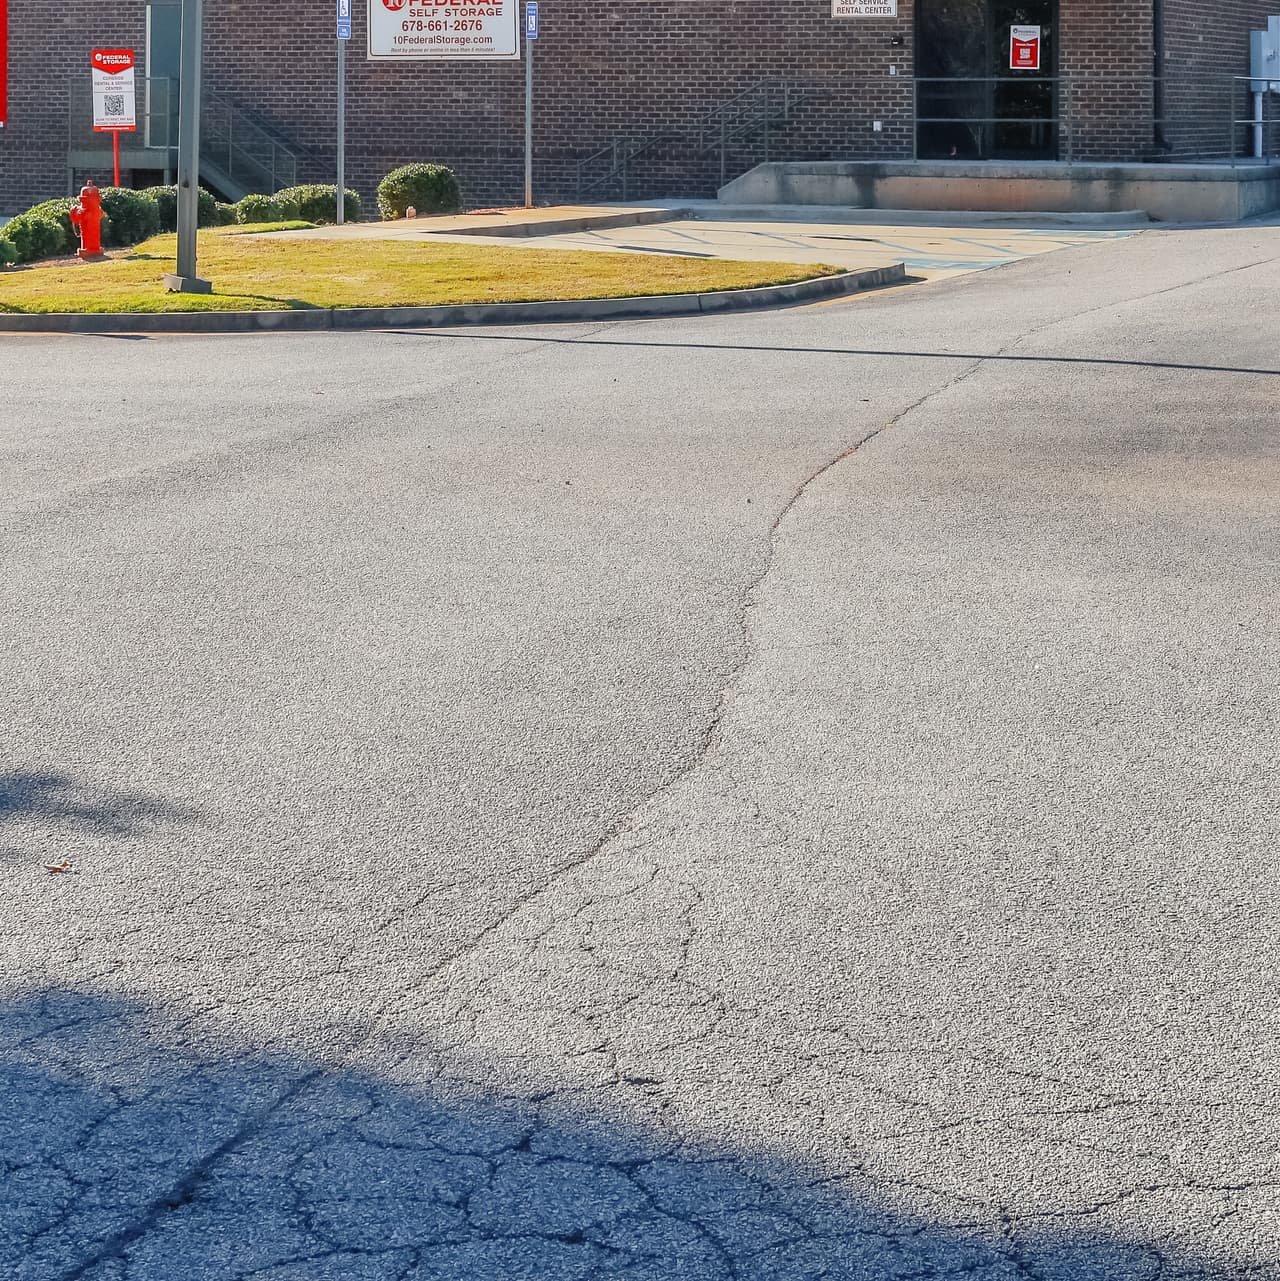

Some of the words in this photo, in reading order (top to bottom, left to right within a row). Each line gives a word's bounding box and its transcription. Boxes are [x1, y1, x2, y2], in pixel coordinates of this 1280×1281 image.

[409, 9, 438, 17] SELF
[445, 8, 503, 17] STORAGE
[865, 6, 892, 14] CENTER
[402, 20, 482, 31] 678-661-2676
[393, 35, 493, 46] 10FederalStorage.com
